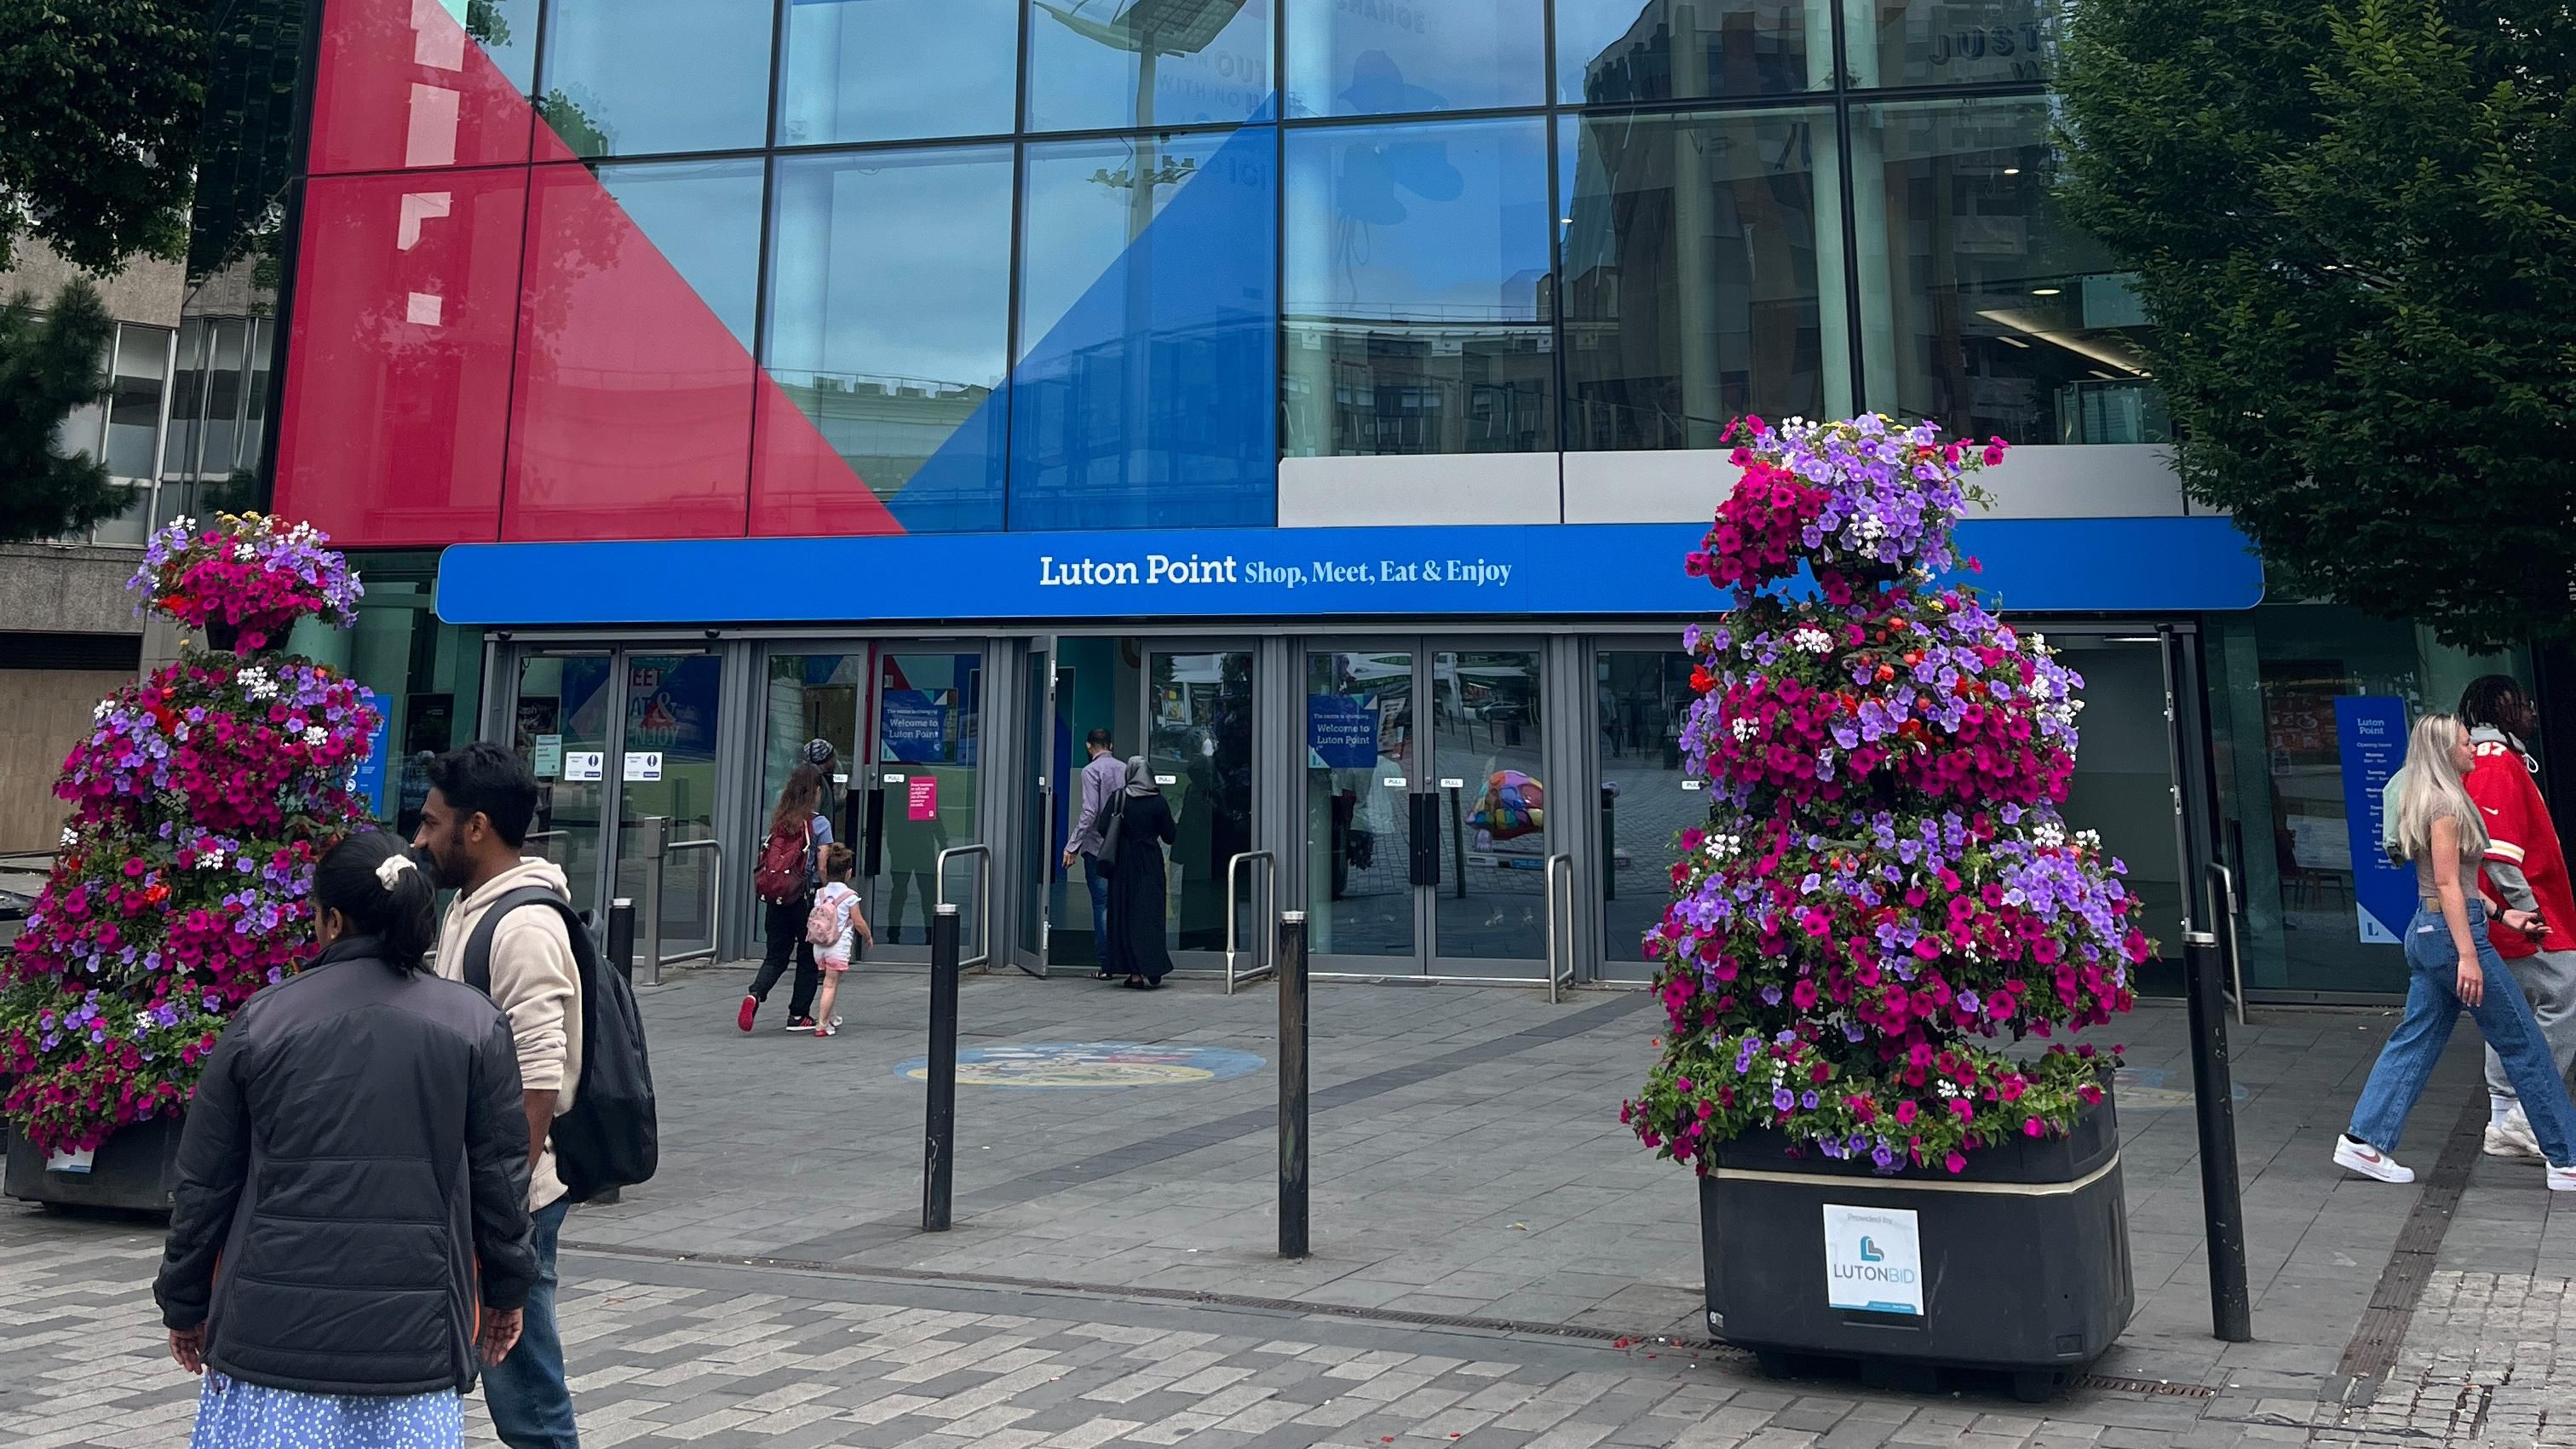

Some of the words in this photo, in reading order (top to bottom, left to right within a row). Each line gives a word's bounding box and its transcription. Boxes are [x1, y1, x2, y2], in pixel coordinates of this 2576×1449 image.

[1929, 22, 2040, 66] JUST
[1040, 556, 1139, 585] Luton
[1147, 554, 1238, 584] Point
[1245, 561, 1308, 589] Shop,
[1312, 561, 1375, 586] Meet,
[1380, 561, 1418, 583] Eat
[1422, 560, 1442, 583] &
[1446, 558, 1512, 587] Enjoy
[632, 668, 664, 687] EET
[630, 696, 652, 716] AT
[889, 718, 928, 727] Welcome
[1317, 723, 1359, 733] Welcome
[1360, 724, 1370, 733] to
[2356, 718, 2385, 727] Luton
[888, 729, 913, 739] Luton
[915, 729, 939, 739] Point
[1316, 735, 1343, 745] Luton
[1345, 735, 1370, 745] Point
[2476, 741, 2507, 756] 87
[1833, 1263, 1915, 1284] LUTONBID
